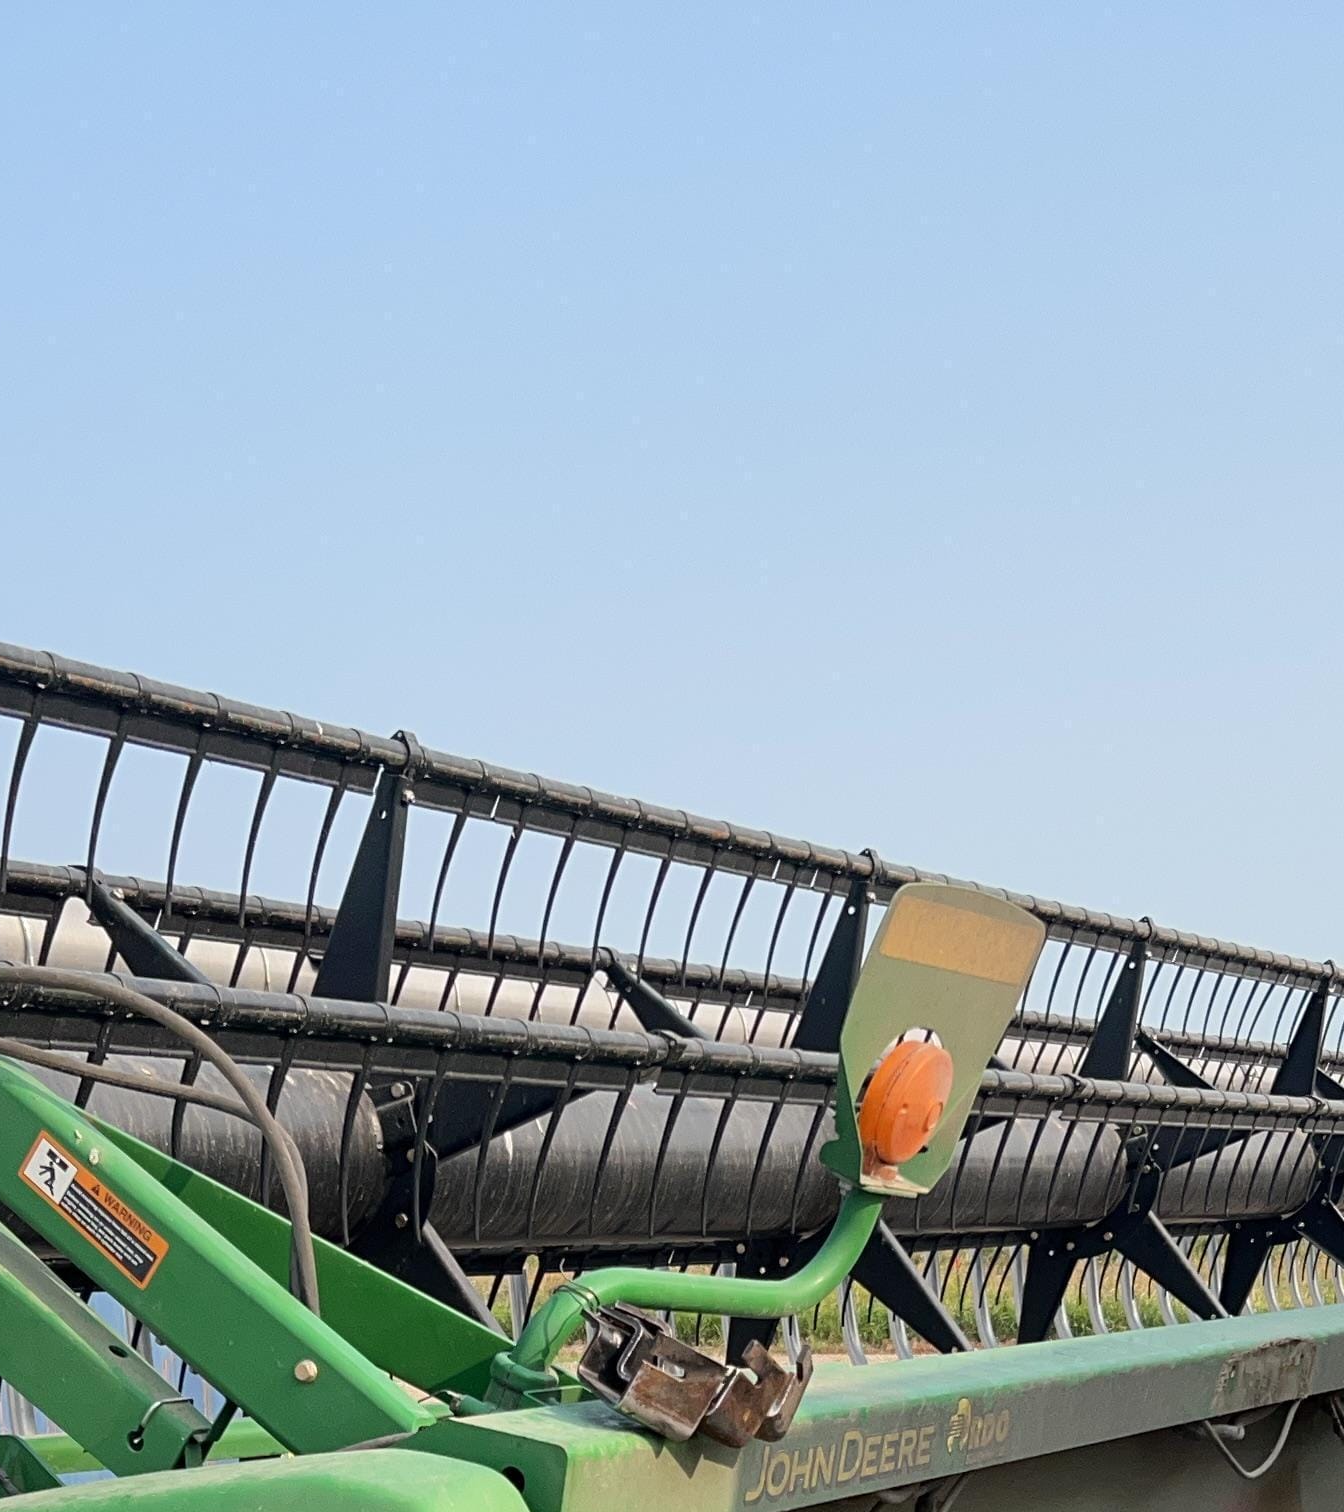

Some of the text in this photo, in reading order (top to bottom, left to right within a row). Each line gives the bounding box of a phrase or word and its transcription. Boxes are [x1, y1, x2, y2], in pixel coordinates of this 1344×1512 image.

[104, 1192, 152, 1242] WARNING
[745, 1426, 936, 1502] JOHN DEERE
